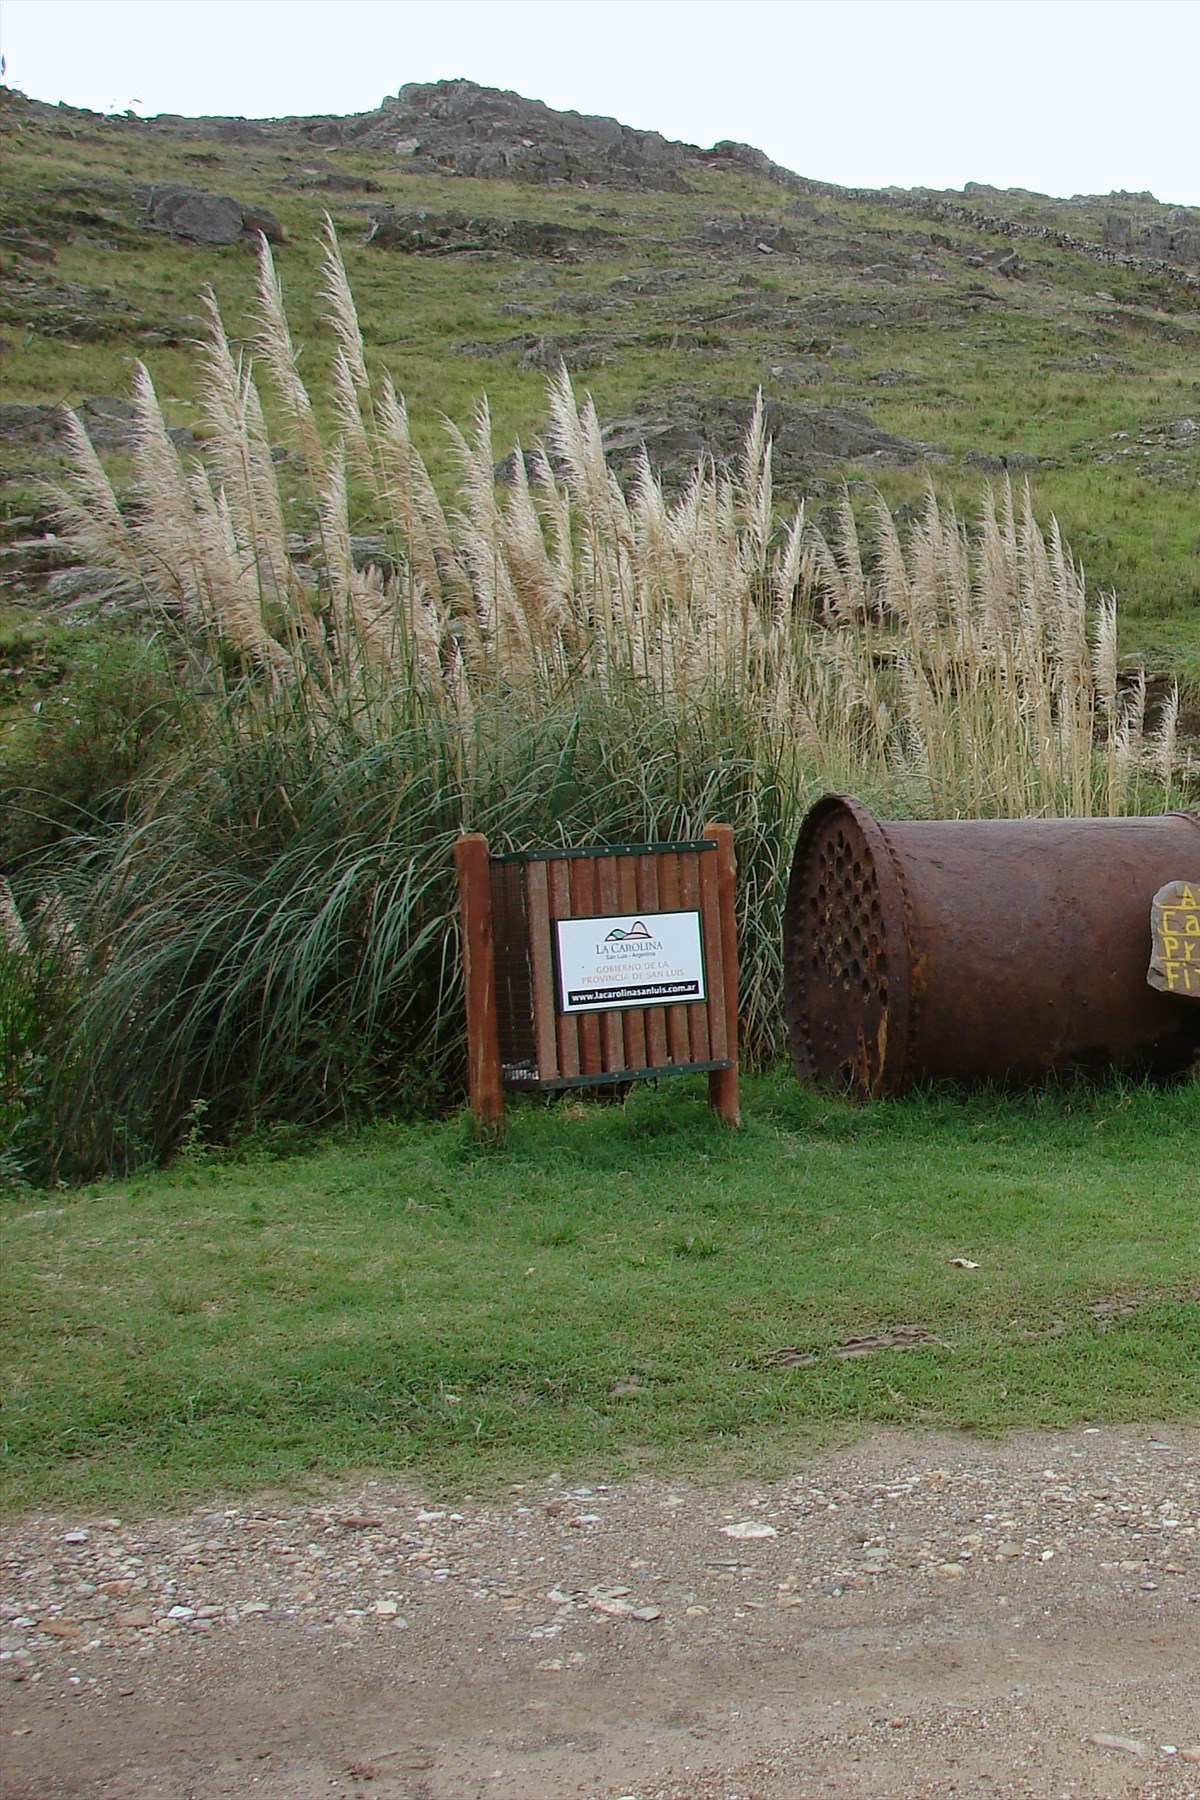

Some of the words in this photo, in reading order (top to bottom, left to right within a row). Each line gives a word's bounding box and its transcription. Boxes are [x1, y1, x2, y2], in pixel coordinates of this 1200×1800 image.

[611, 941, 663, 953] CAROLINA
[596, 963, 641, 973] GOBIERNO
[582, 973, 629, 984] PROVINCIA
[632, 972, 643, 980] DE
[666, 969, 685, 977] LUIS
[571, 983, 696, 1001] www.lacarolinasanluis.com.ar
